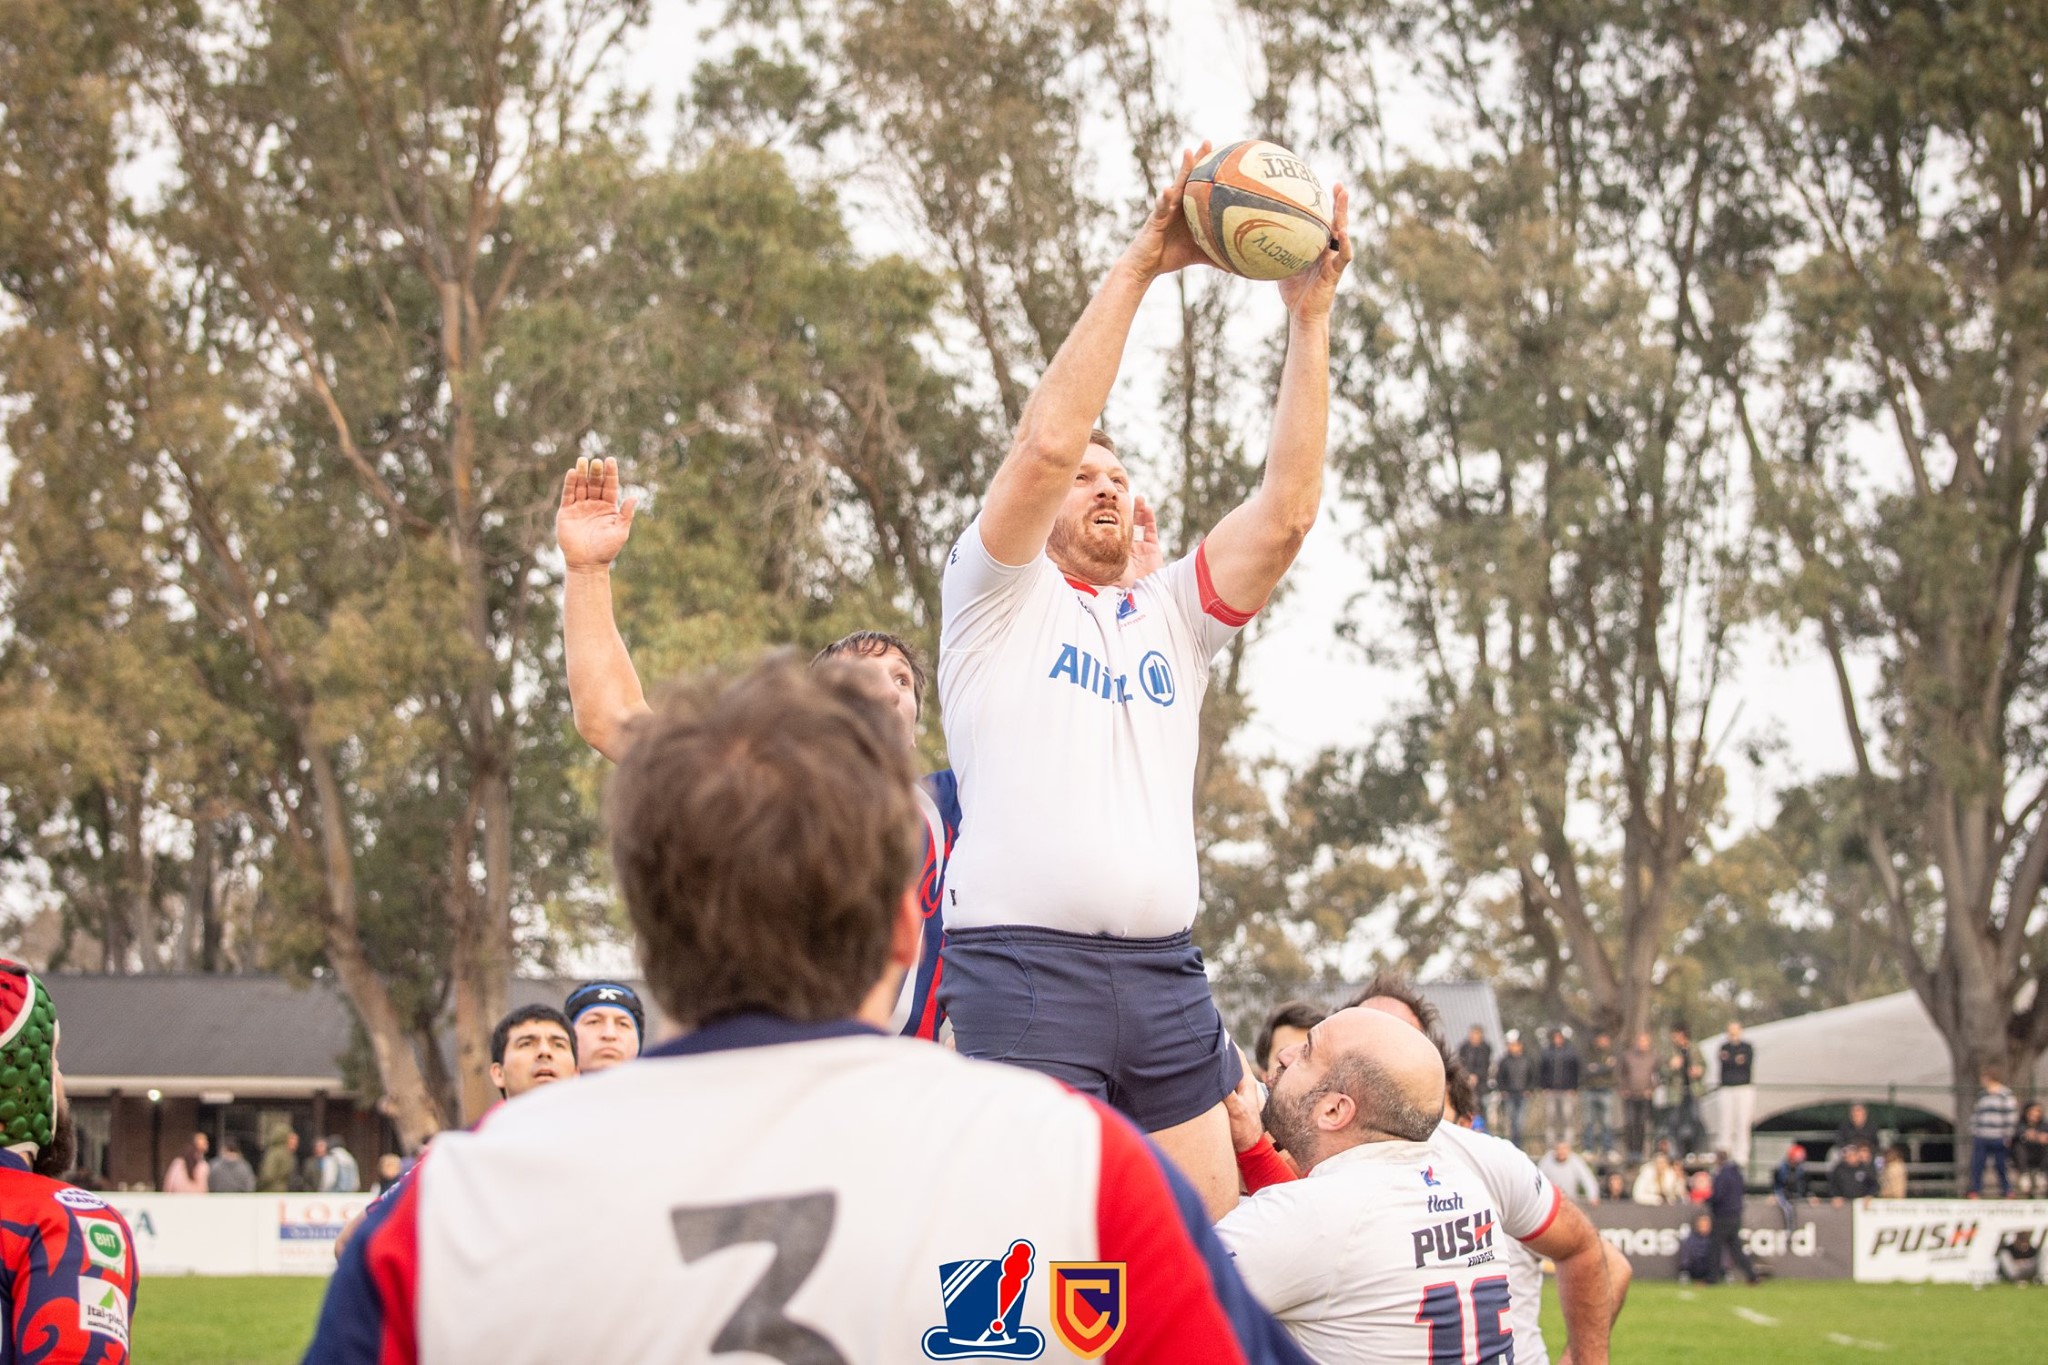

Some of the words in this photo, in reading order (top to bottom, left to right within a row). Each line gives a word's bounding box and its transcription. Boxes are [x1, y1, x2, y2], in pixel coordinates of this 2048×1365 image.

[1252, 235, 1299, 271] DIRECTV
[1048, 643, 1134, 703] Alliz
[93, 1232, 116, 1249] BHT
[1411, 1208, 1496, 1269] PUSH
[1870, 1219, 1979, 1257] PUSH
[671, 1190, 850, 1365] 3
